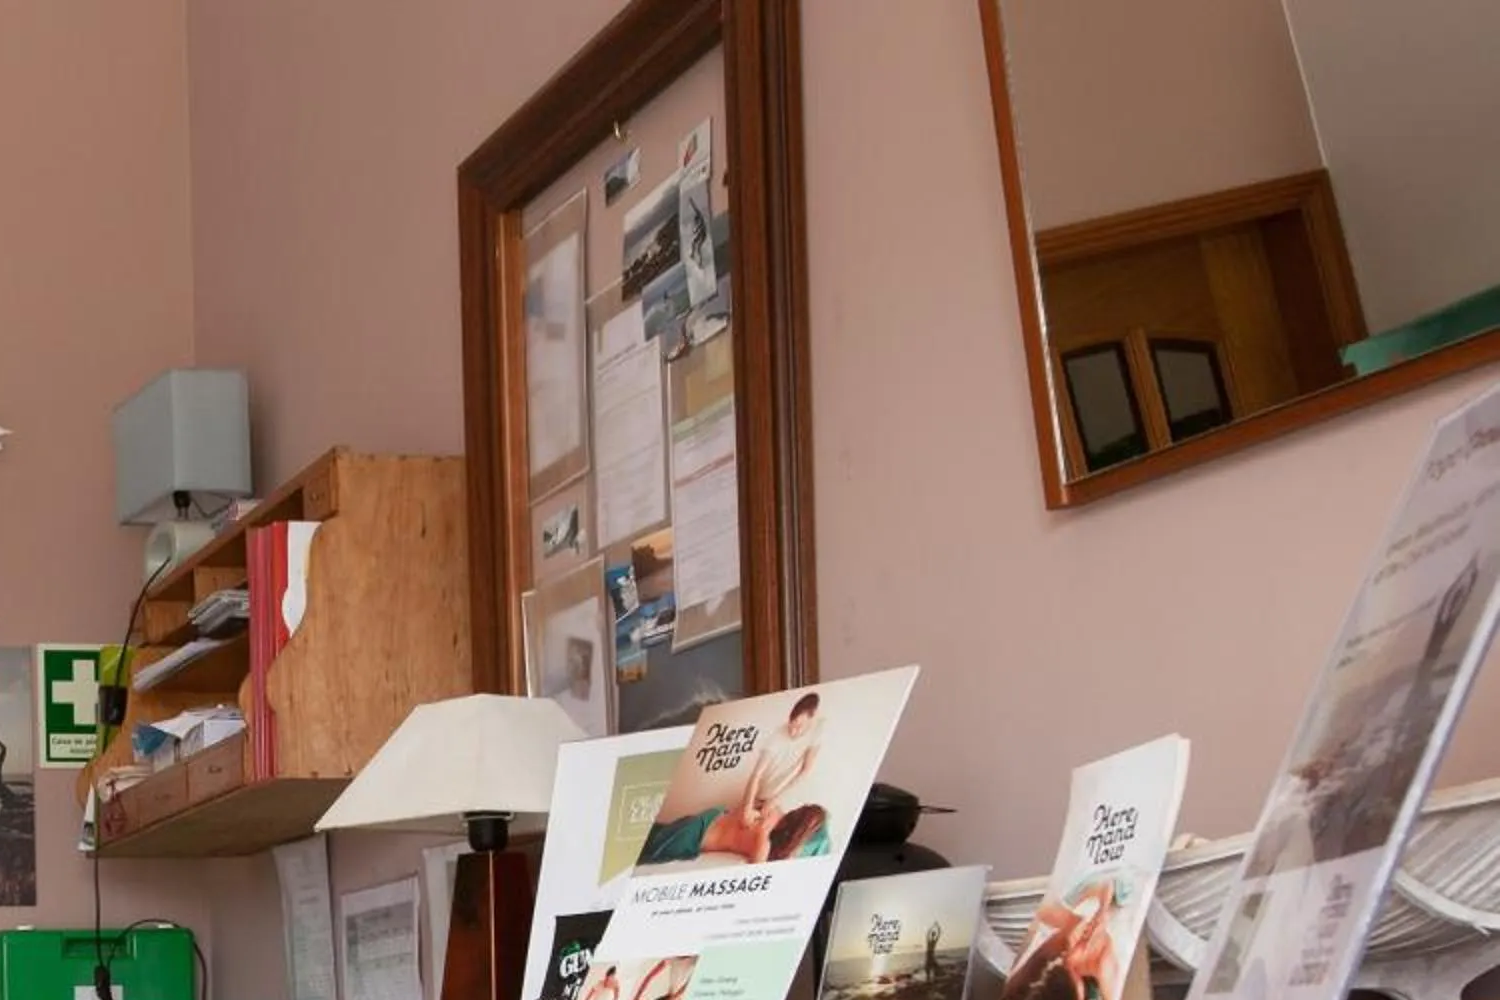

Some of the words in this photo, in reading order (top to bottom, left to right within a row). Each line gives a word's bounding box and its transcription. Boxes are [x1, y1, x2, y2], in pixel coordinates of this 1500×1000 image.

[706, 723, 756, 745] Here
[1093, 804, 1136, 832] Here
[633, 883, 689, 904] MOBILE
[689, 875, 773, 898] MASSAGE
